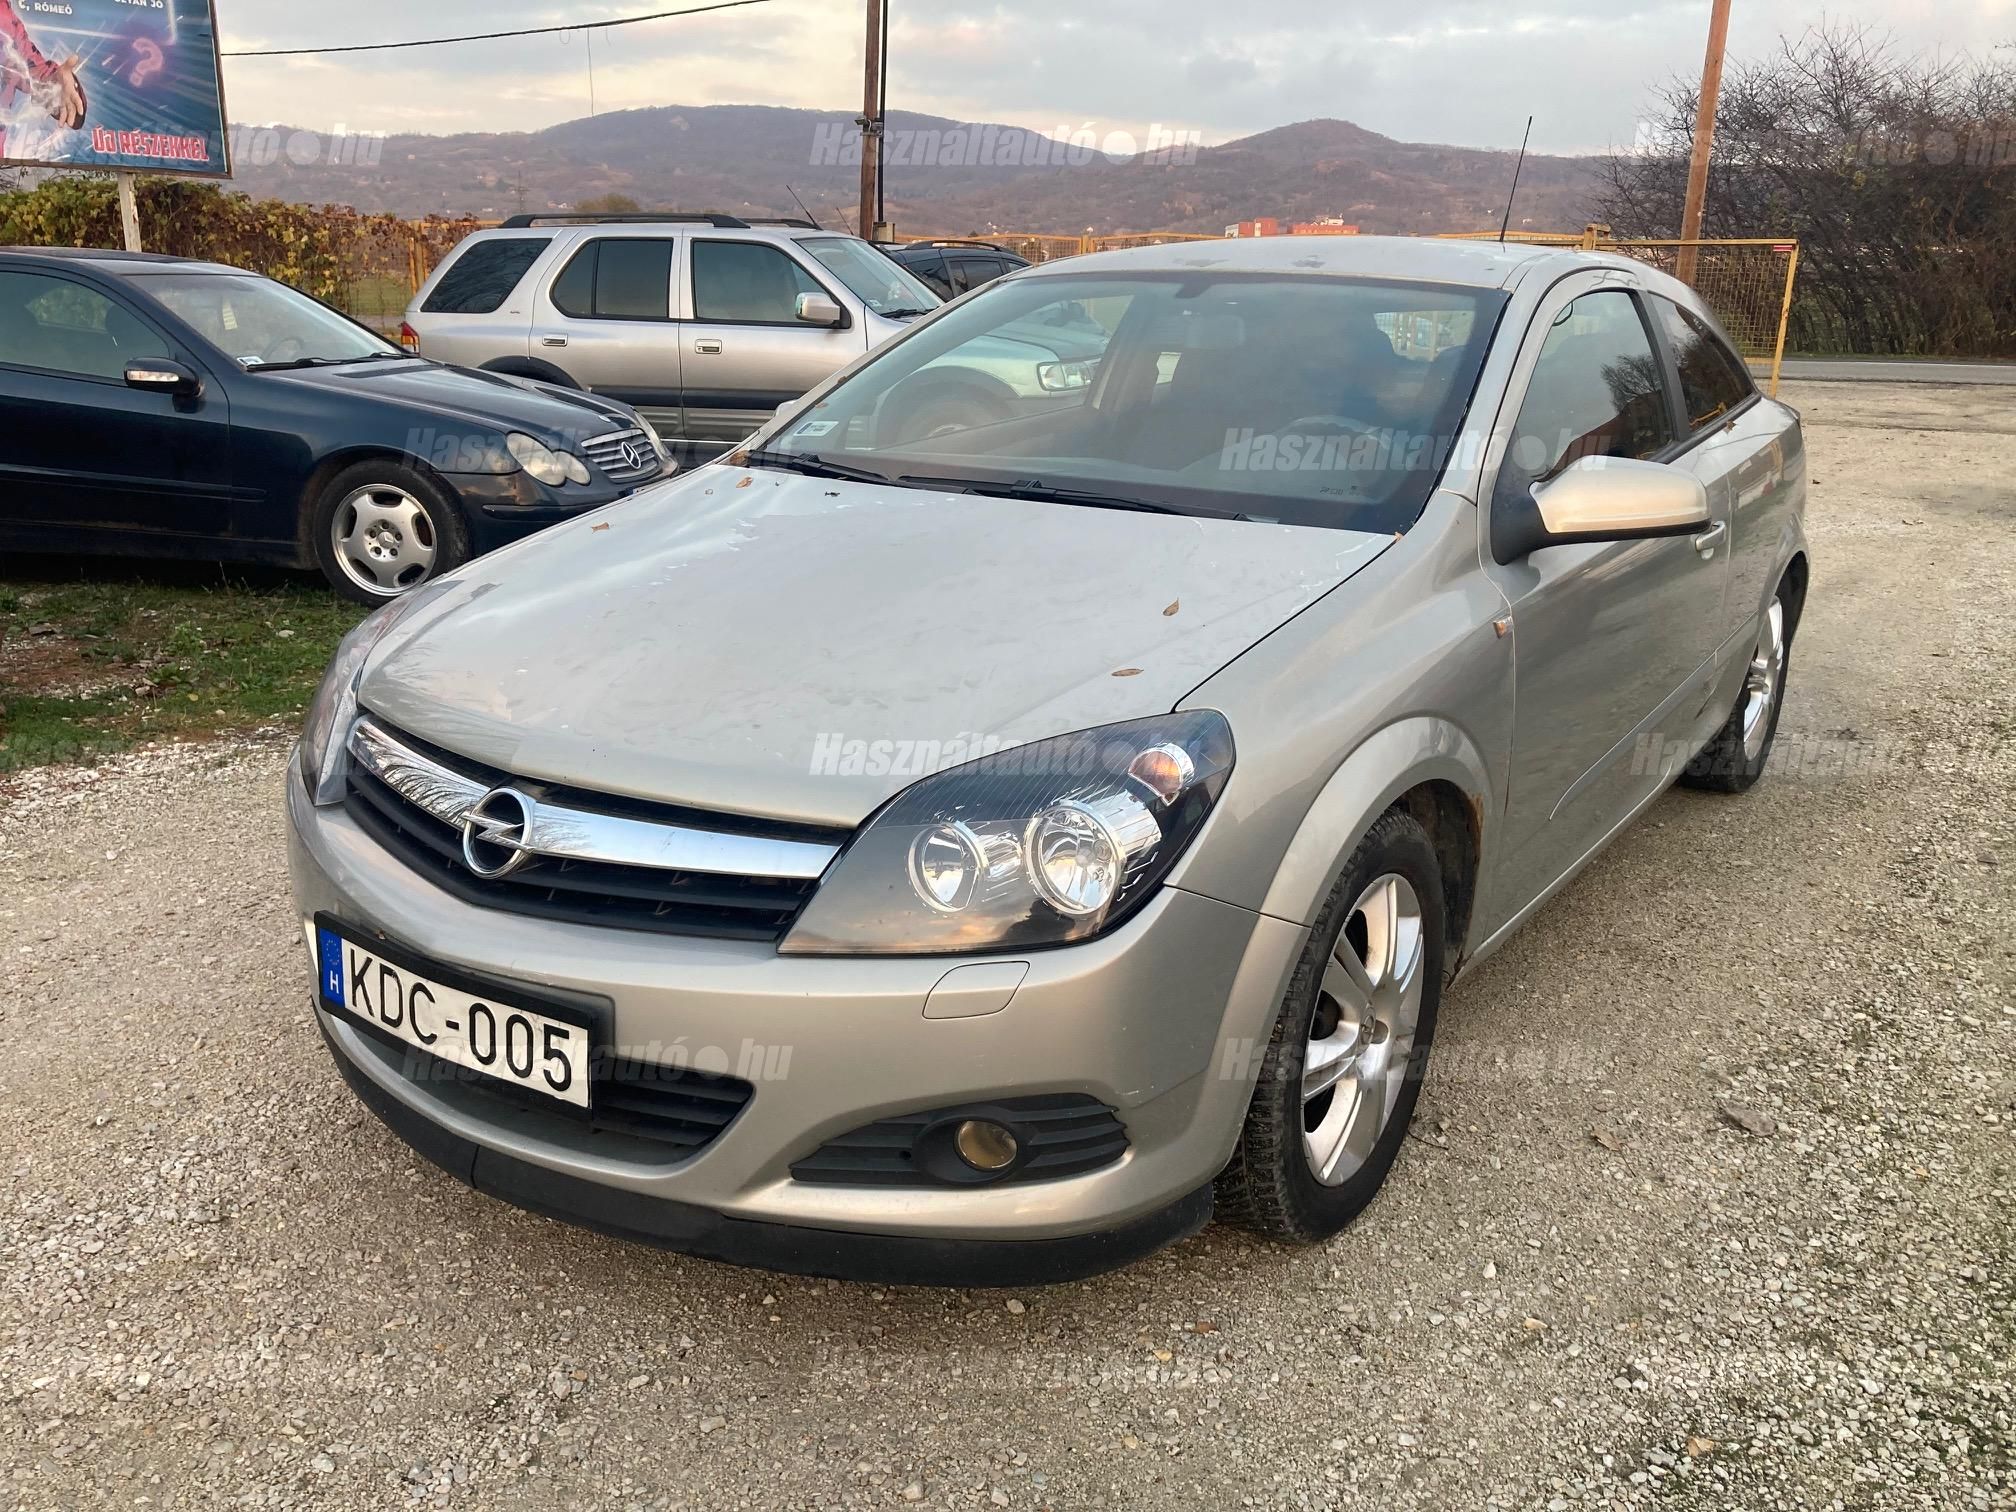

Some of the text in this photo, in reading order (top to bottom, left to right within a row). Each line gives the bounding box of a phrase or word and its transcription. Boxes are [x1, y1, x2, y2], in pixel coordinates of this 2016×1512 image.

[34, 2, 73, 15] RÓMEÓ
[91, 124, 210, 162] ÚJ RÉSZEKKEL
[329, 970, 340, 995] H
[349, 947, 572, 1092] KDC-005
